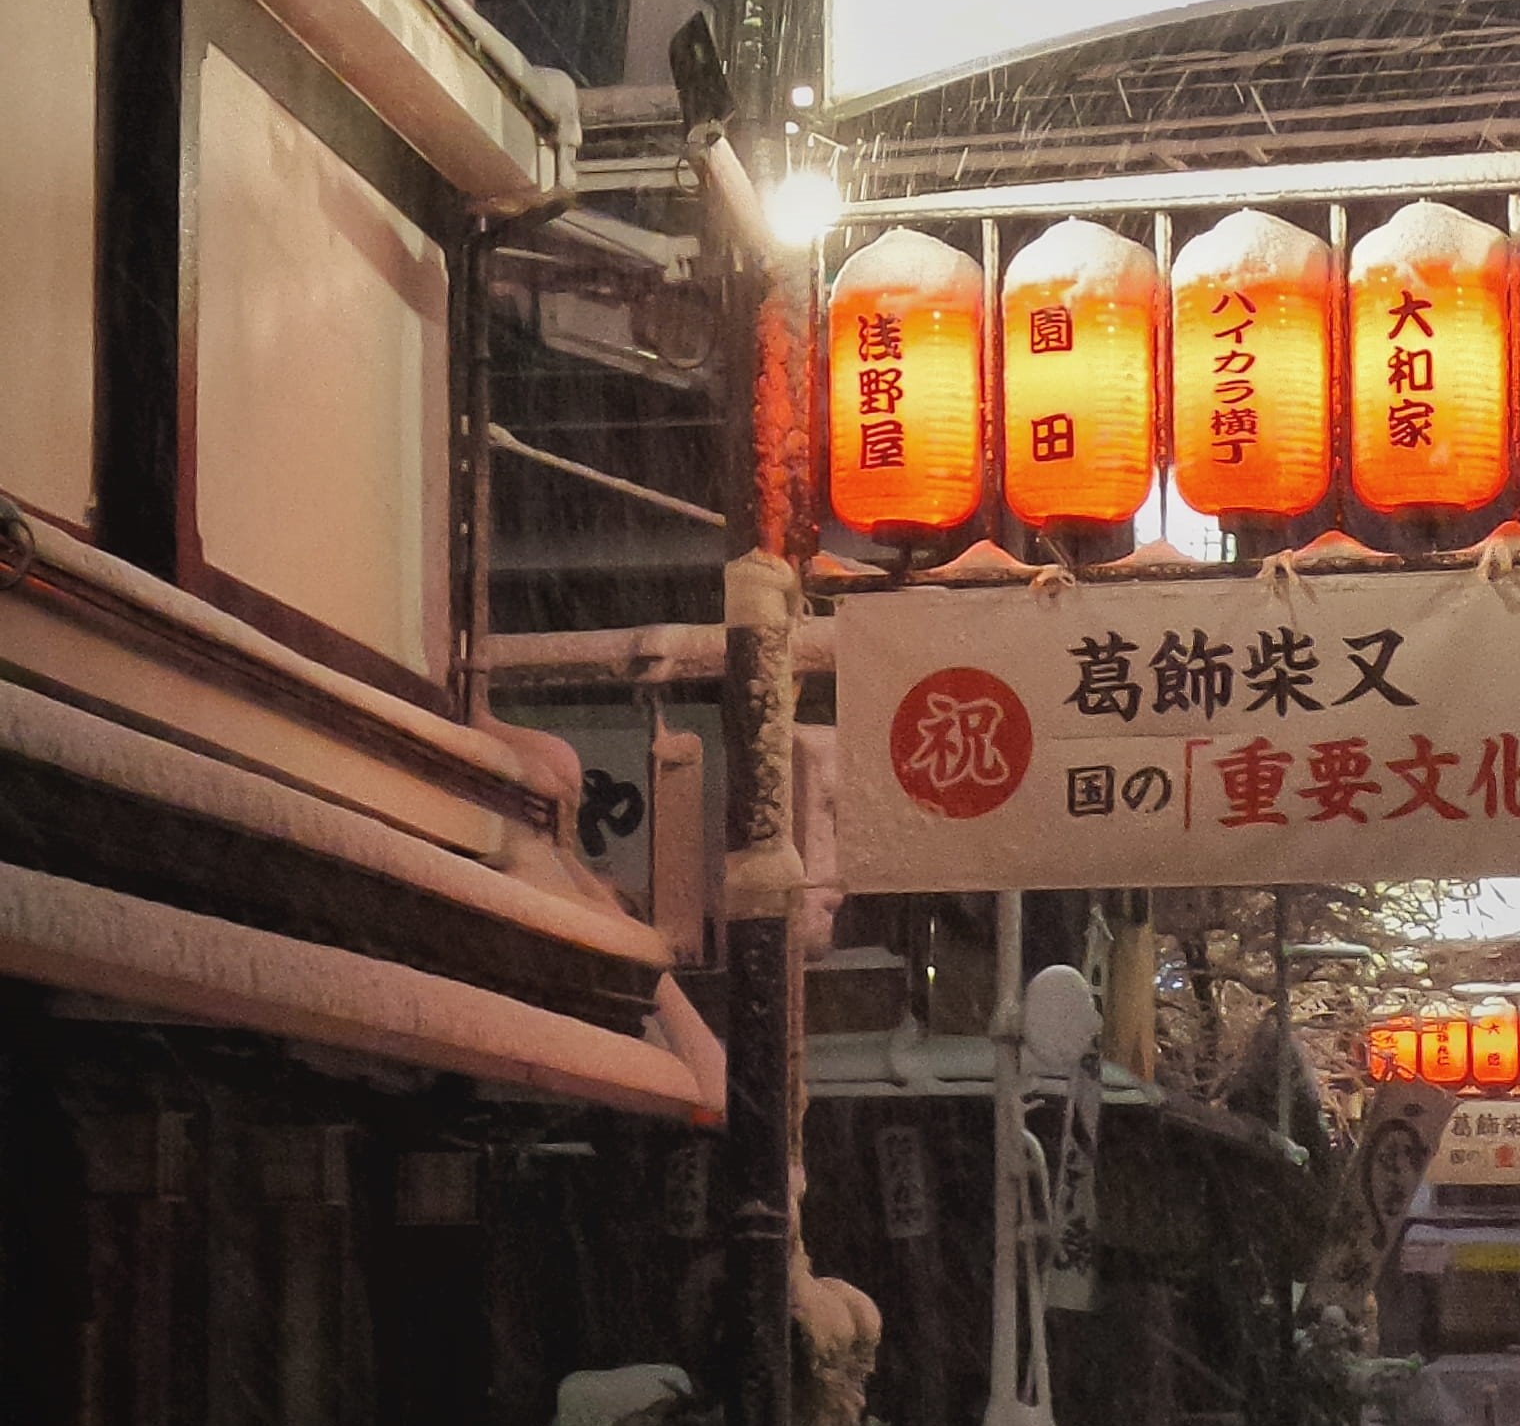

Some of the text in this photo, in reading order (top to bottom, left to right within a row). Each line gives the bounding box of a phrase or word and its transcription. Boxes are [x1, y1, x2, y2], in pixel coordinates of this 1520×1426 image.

[857, 313, 905, 469] 浅野屋
[1030, 307, 1075, 462] 園田
[1210, 291, 1257, 464] ハイカラ横丁
[1387, 291, 1433, 448] 大和家
[910, 692, 1006, 788] 祝
[1063, 626, 1419, 721] 葛飾柴又
